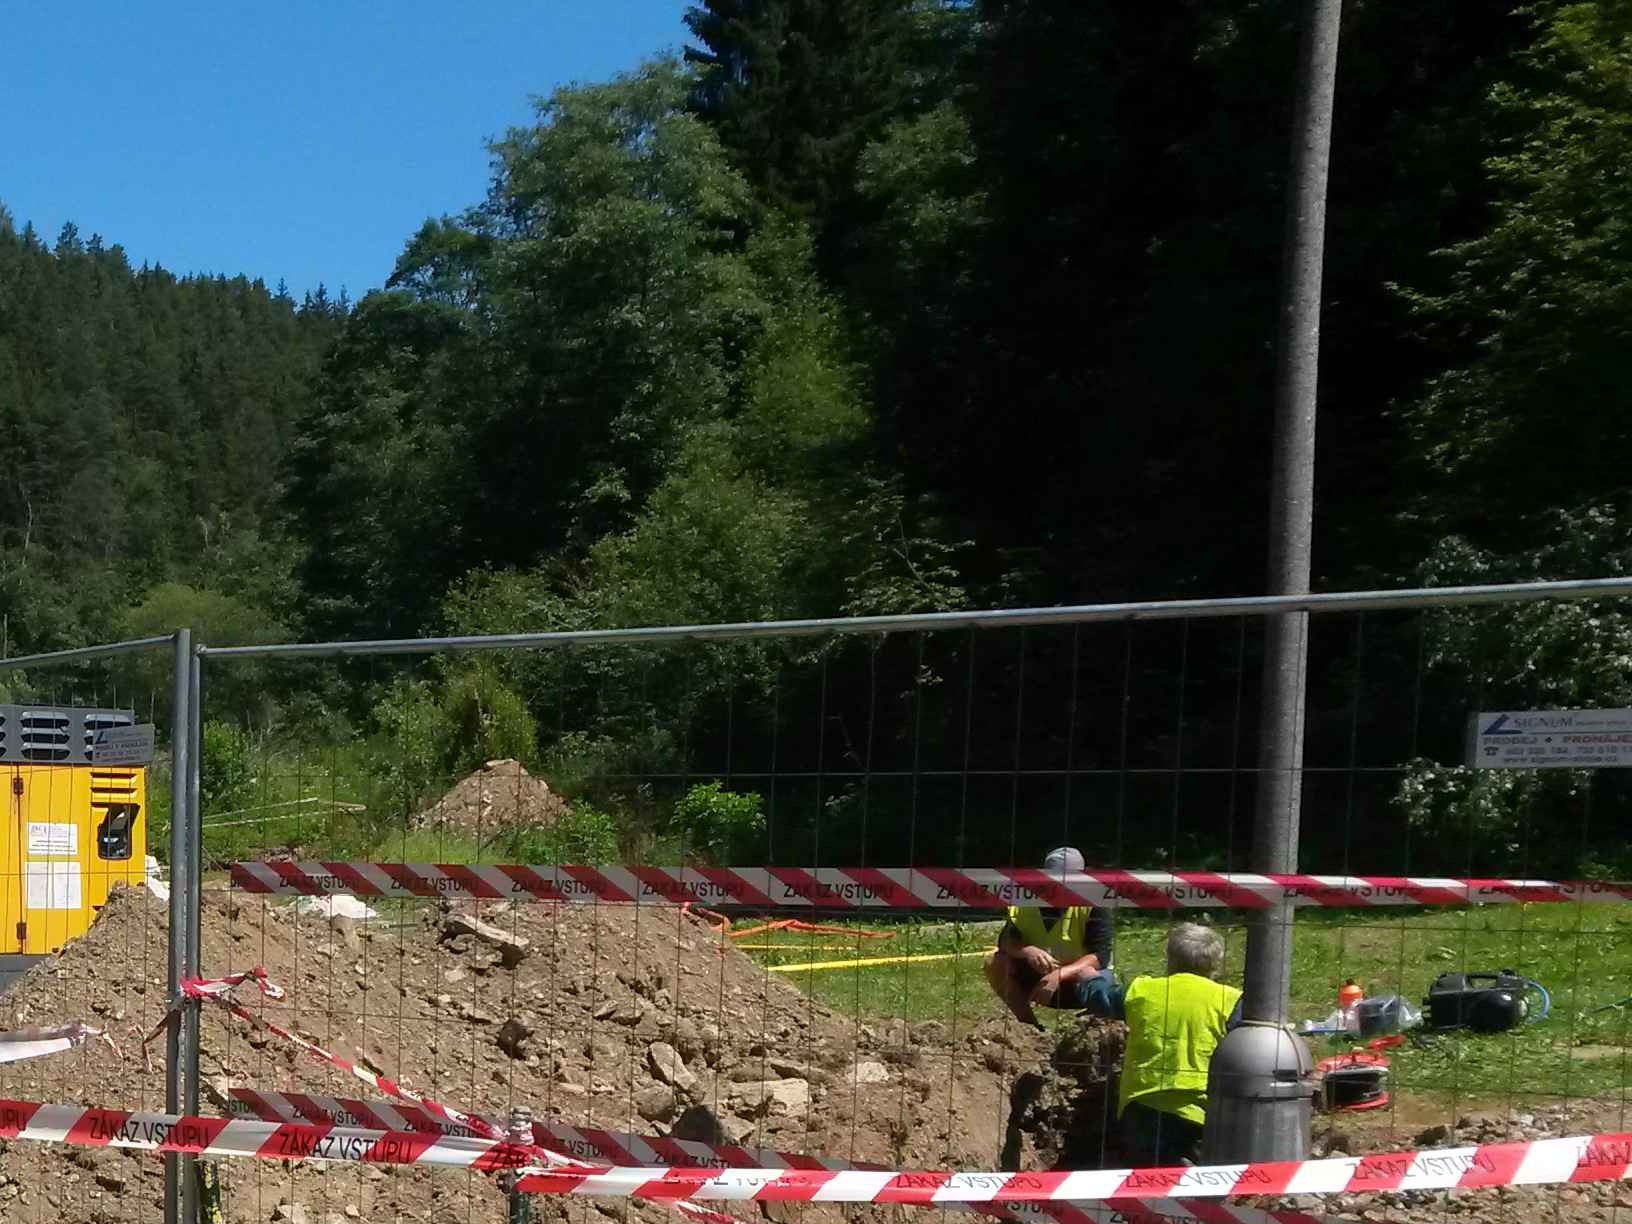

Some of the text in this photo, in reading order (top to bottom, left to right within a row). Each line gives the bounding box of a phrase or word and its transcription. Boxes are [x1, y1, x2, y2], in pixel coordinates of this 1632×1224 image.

[88, 1112, 210, 1149] ZÁKAZ VSTUPU
[280, 1127, 414, 1163] ZÁKAZ VSTUPU
